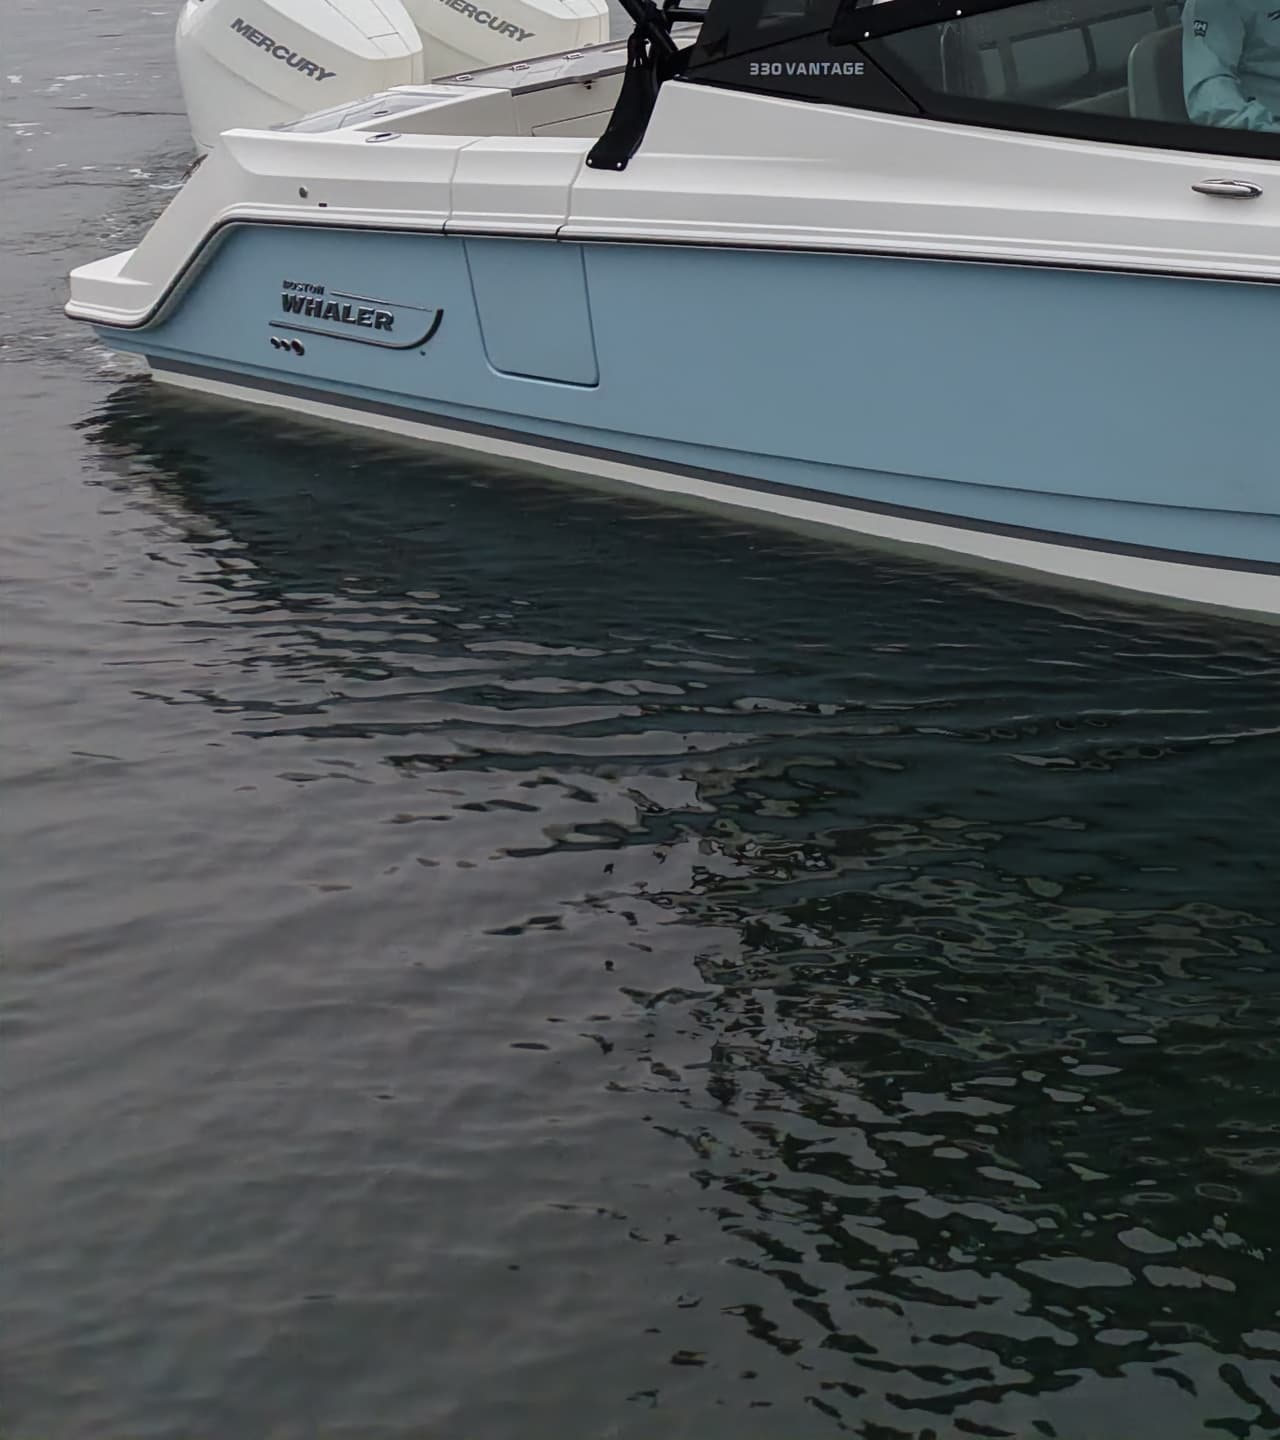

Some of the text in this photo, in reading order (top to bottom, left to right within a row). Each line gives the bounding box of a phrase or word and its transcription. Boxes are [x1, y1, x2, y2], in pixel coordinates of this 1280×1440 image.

[230, 18, 337, 82] MERCURY
[749, 62, 865, 76] 330 VANTAGE
[280, 291, 395, 332] WHALER
